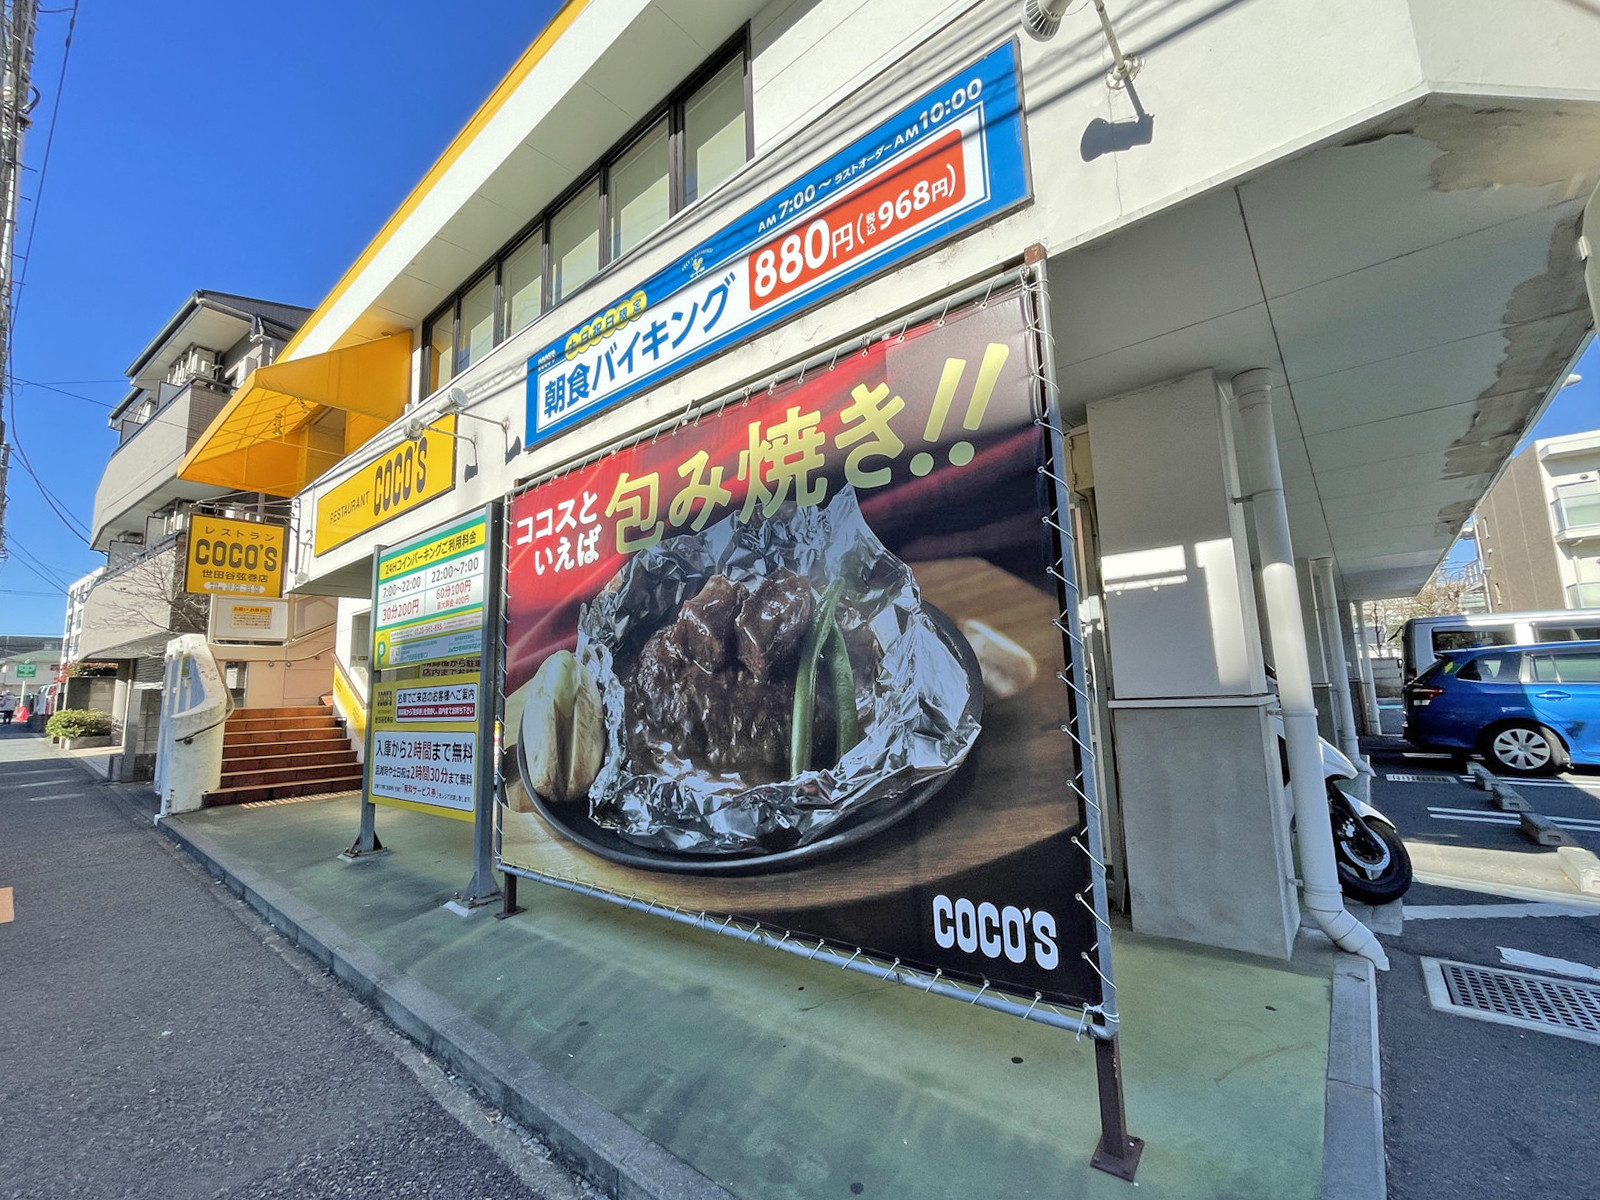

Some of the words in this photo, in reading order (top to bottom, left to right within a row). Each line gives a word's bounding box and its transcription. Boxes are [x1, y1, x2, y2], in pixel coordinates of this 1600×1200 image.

[544, 271, 736, 418] 朝食バイキング
[329, 490, 370, 524] RESTAURANT
[373, 437, 428, 517] COCO'S
[205, 526, 275, 542] レストラン
[516, 490, 598, 545] ココスと
[195, 538, 278, 572] COCO'S
[534, 525, 602, 576] いえば
[202, 569, 269, 583] 世田谷弦巻店
[436, 580, 472, 600] 60分100円
[382, 599, 420, 621] 30分200円
[375, 739, 474, 764] 入庫から2時間まで無料
[933, 894, 1059, 970] COCO'S
